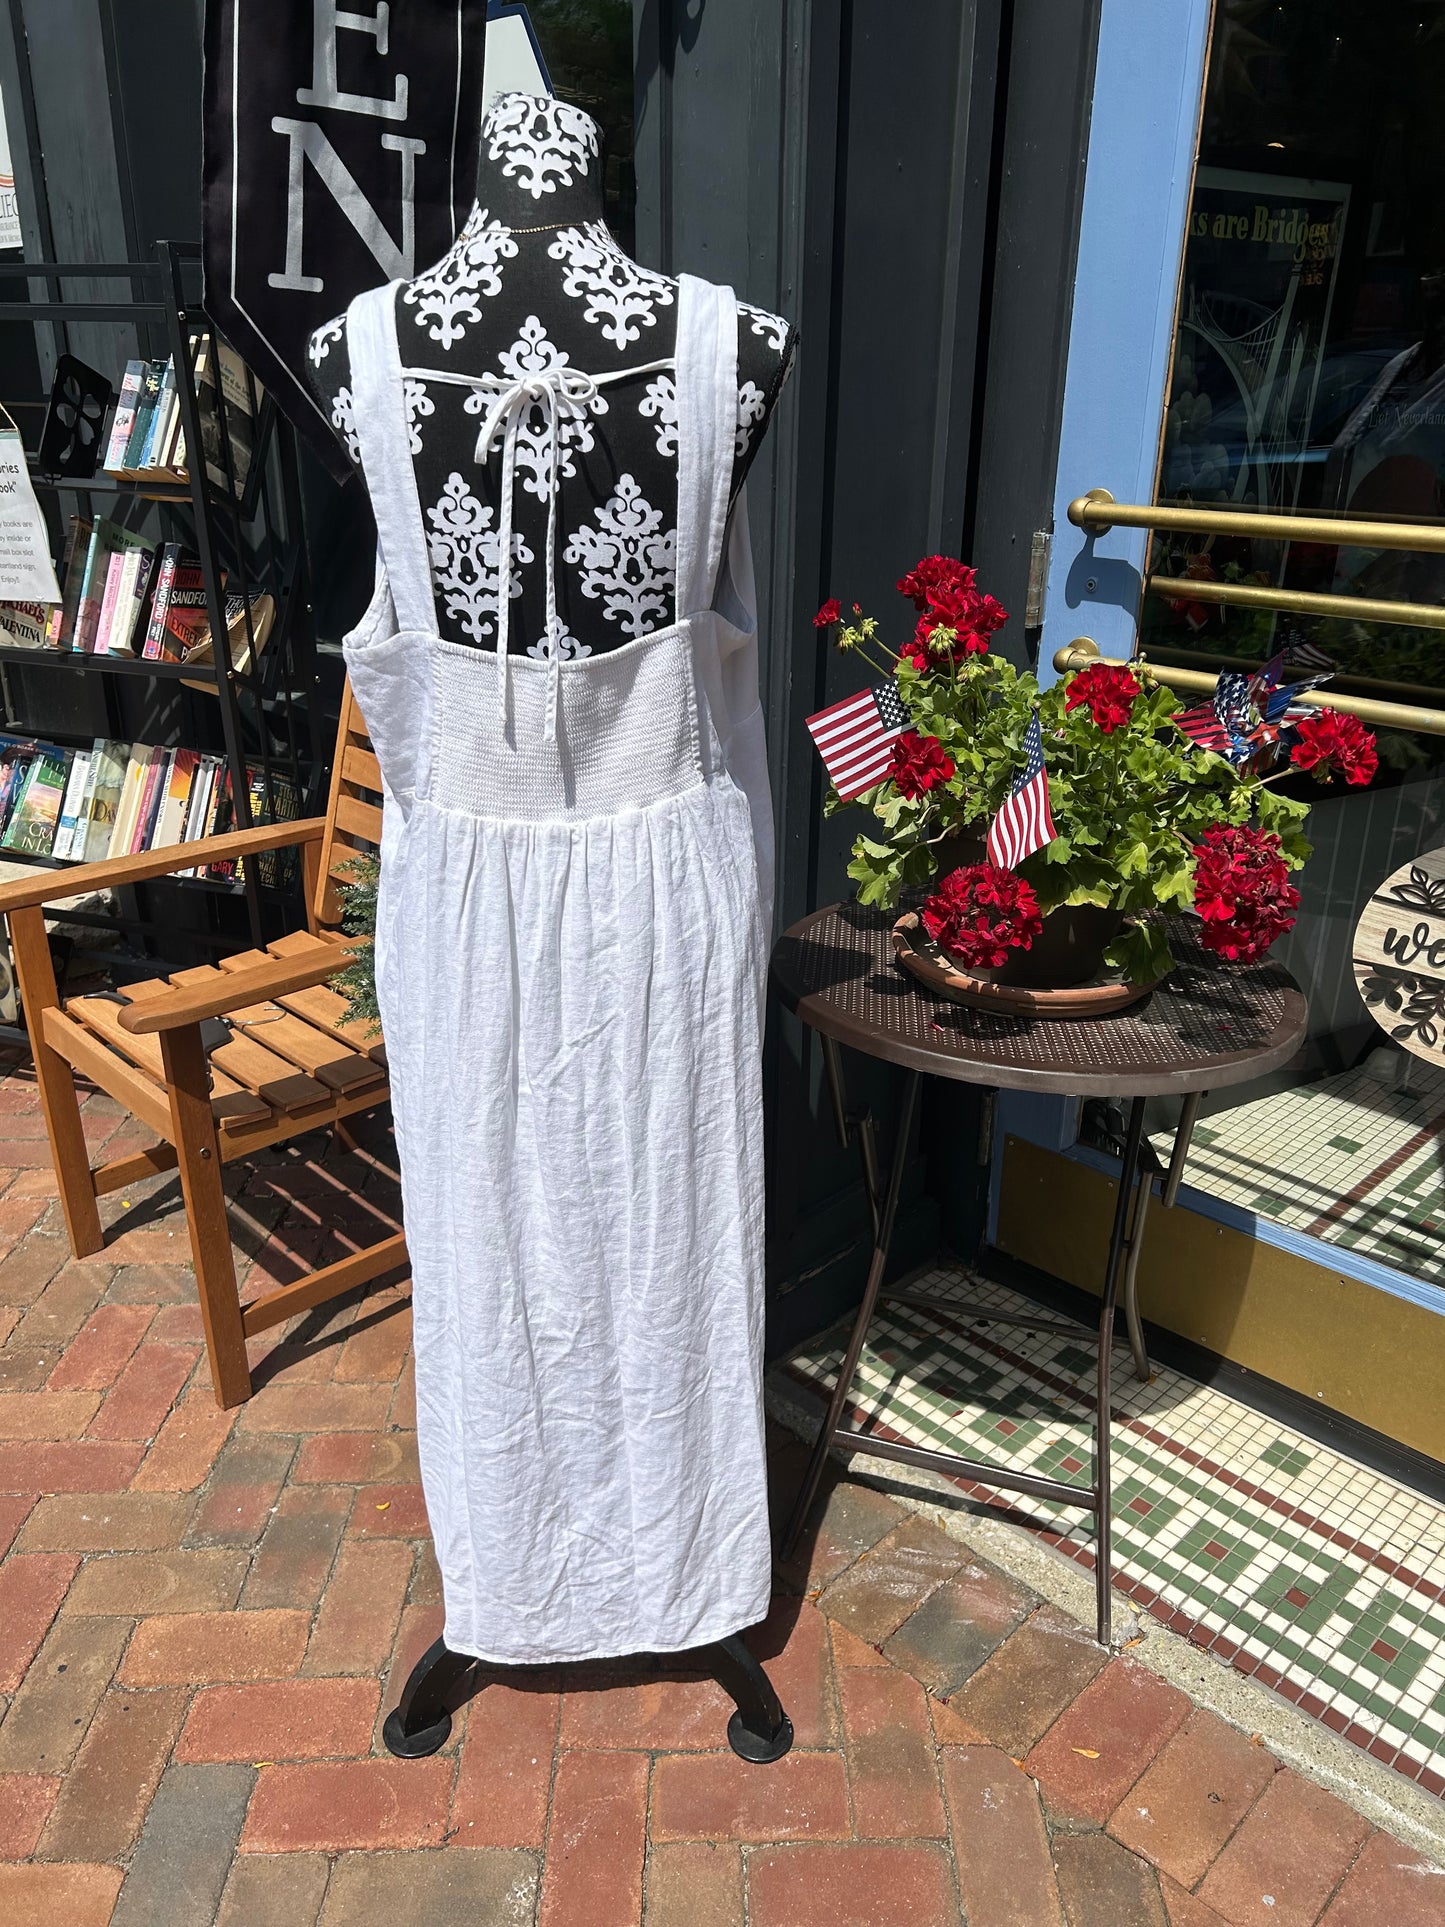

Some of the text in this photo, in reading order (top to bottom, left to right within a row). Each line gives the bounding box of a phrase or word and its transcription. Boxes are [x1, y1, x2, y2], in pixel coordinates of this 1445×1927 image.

[1212, 213, 1249, 240] are
[1251, 205, 1329, 263] Bridges
[112, 532, 136, 548] MORE
[153, 553, 176, 620] JOHN SANDFORD
[171, 591, 207, 605] SANDFO
[22, 836, 35, 850] IN
[211, 860, 234, 875] GARY
